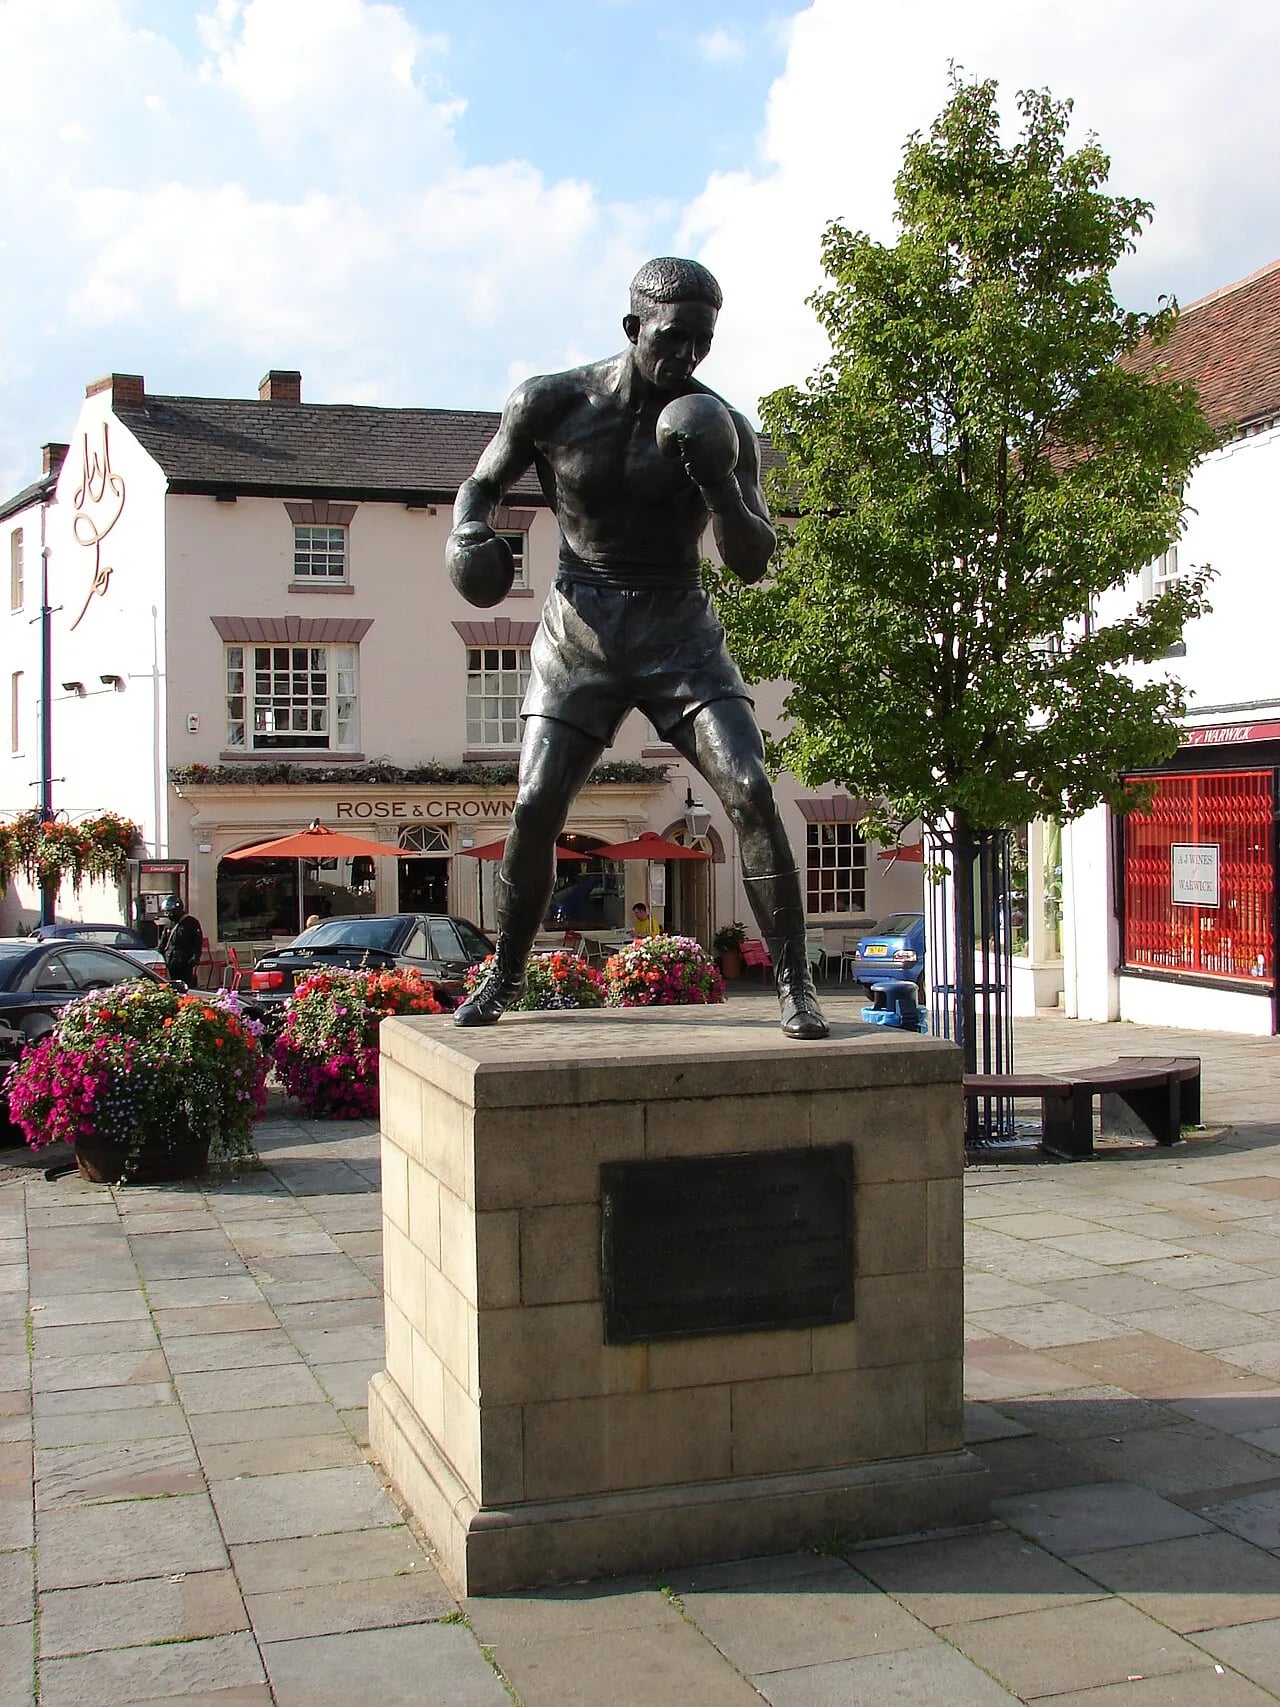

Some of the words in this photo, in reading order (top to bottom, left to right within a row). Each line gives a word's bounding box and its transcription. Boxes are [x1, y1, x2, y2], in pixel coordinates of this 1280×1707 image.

[1203, 727, 1253, 742] WARWICK
[337, 802, 407, 818] ROSE
[412, 804, 424, 817] &
[426, 800, 516, 818] CROWN
[1178, 880, 1213, 891] WARWICK
